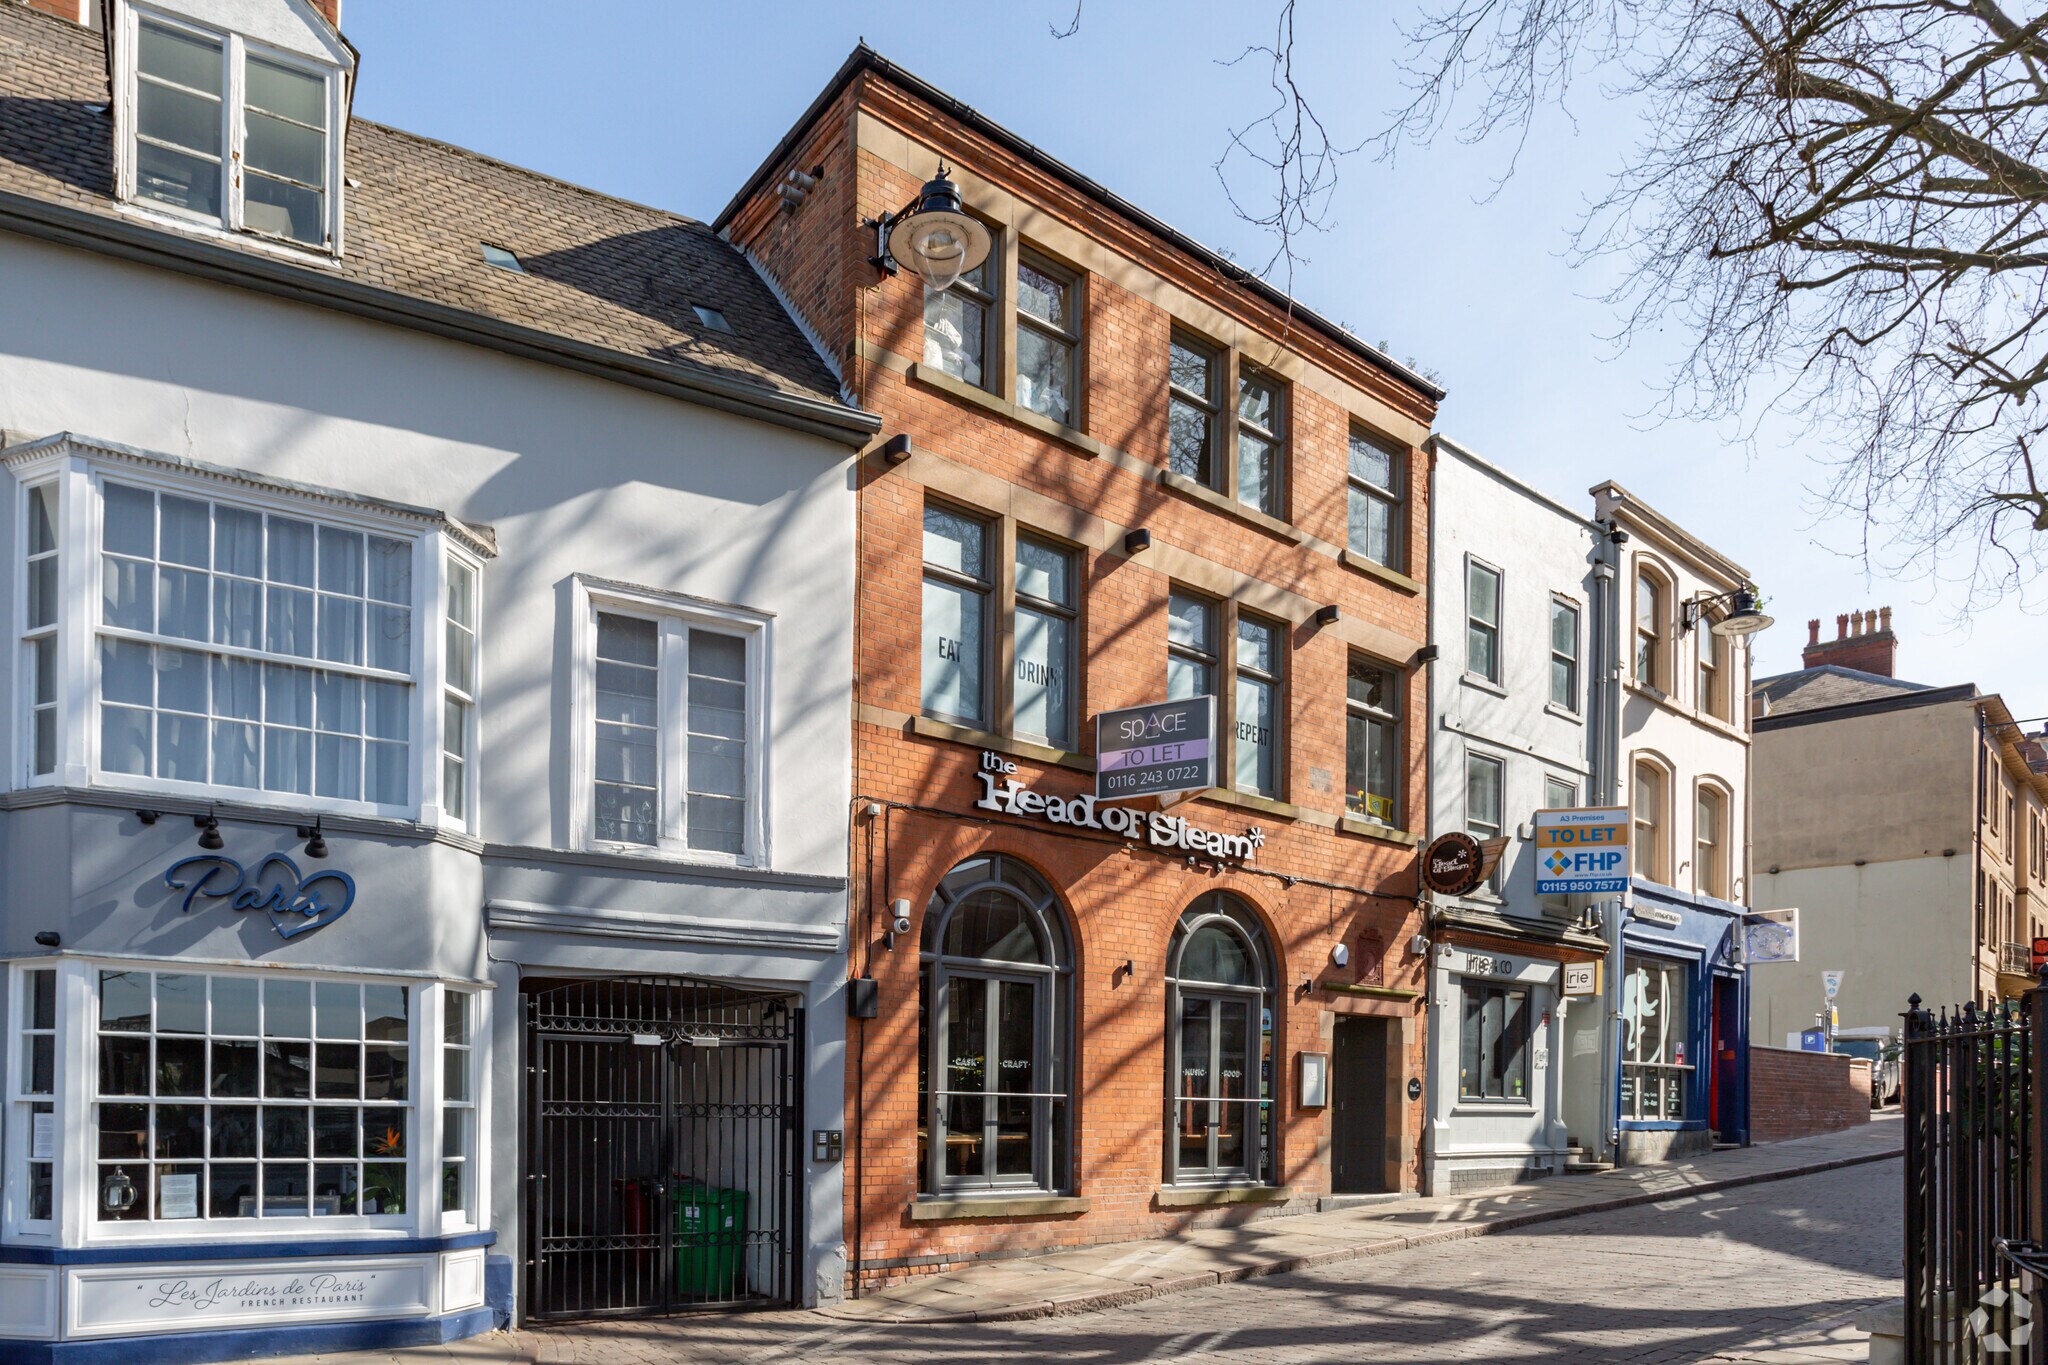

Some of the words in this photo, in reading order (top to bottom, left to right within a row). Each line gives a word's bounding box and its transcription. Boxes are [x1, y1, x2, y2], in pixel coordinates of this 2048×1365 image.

[938, 636, 963, 662] EAT
[1018, 659, 1057, 687] DRINK
[1236, 721, 1269, 746] REPEAT
[981, 750, 1018, 774] the
[1121, 749, 1144, 766] TO
[1152, 743, 1185, 763] LET
[1108, 774, 1136, 789] 0116
[1140, 770, 1163, 785] 243
[1167, 765, 1199, 780] 0722
[977, 772, 1101, 829] Head
[1148, 810, 1254, 860] Steam
[1548, 829, 1575, 843] TO
[1579, 827, 1616, 842] LET
[1574, 852, 1622, 872] FHP
[165, 854, 332, 918] Paris
[1542, 882, 1568, 892] 0115
[1569, 881, 1593, 891] 950
[1594, 880, 1623, 890] 7577
[1500, 960, 1512, 974] CO
[1566, 971, 1589, 984] Irie
[955, 1057, 977, 1067] CASK
[1002, 1060, 1028, 1069] CRAFT
[1184, 1068, 1206, 1077] MUSIC
[149, 1280, 199, 1308] Les
[194, 1278, 278, 1310] Jardins
[282, 1278, 306, 1296] de
[309, 1273, 367, 1294] Paris
[241, 1298, 285, 1308] FRENCH
[292, 1294, 365, 1305] RESTAURANT
